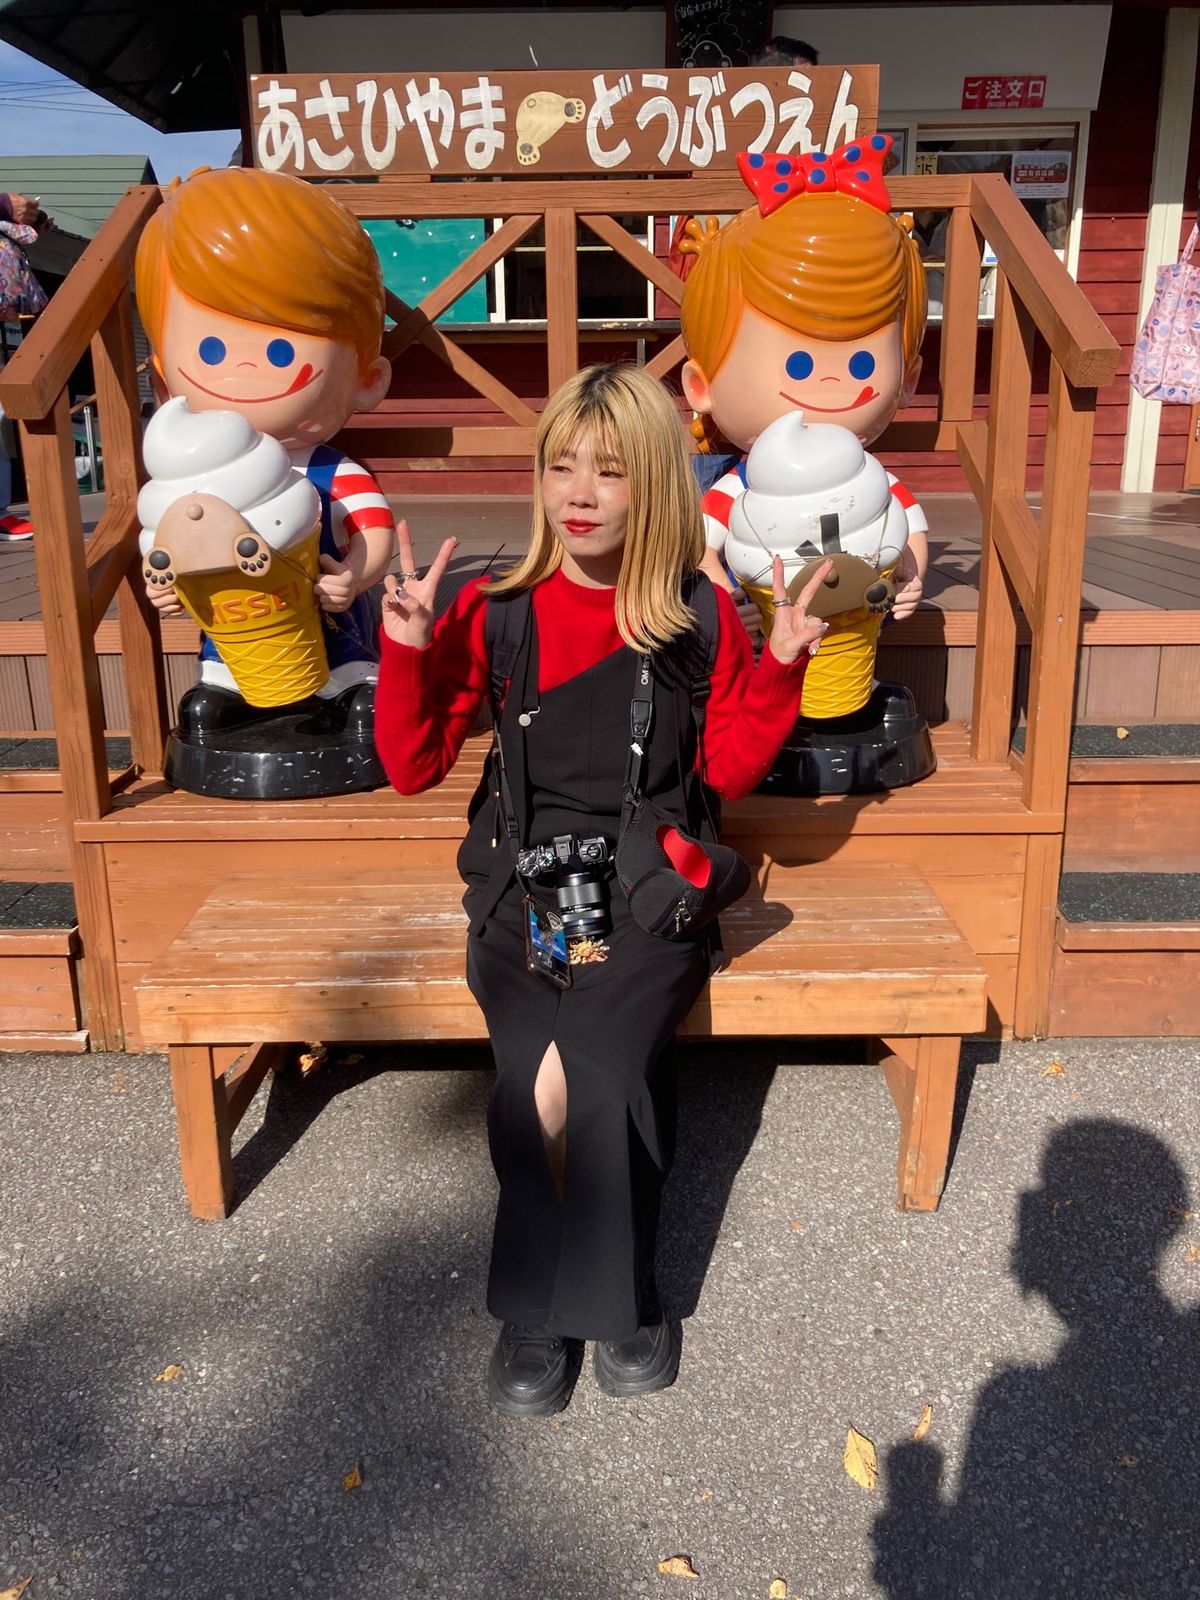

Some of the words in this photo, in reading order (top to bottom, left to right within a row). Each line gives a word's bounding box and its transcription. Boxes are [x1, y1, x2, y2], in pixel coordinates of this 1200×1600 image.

[965, 80, 1044, 99] ご注文口
[258, 76, 506, 171] あさひやま
[586, 70, 860, 168] どうぶつえん
[641, 670, 648, 685] OM
